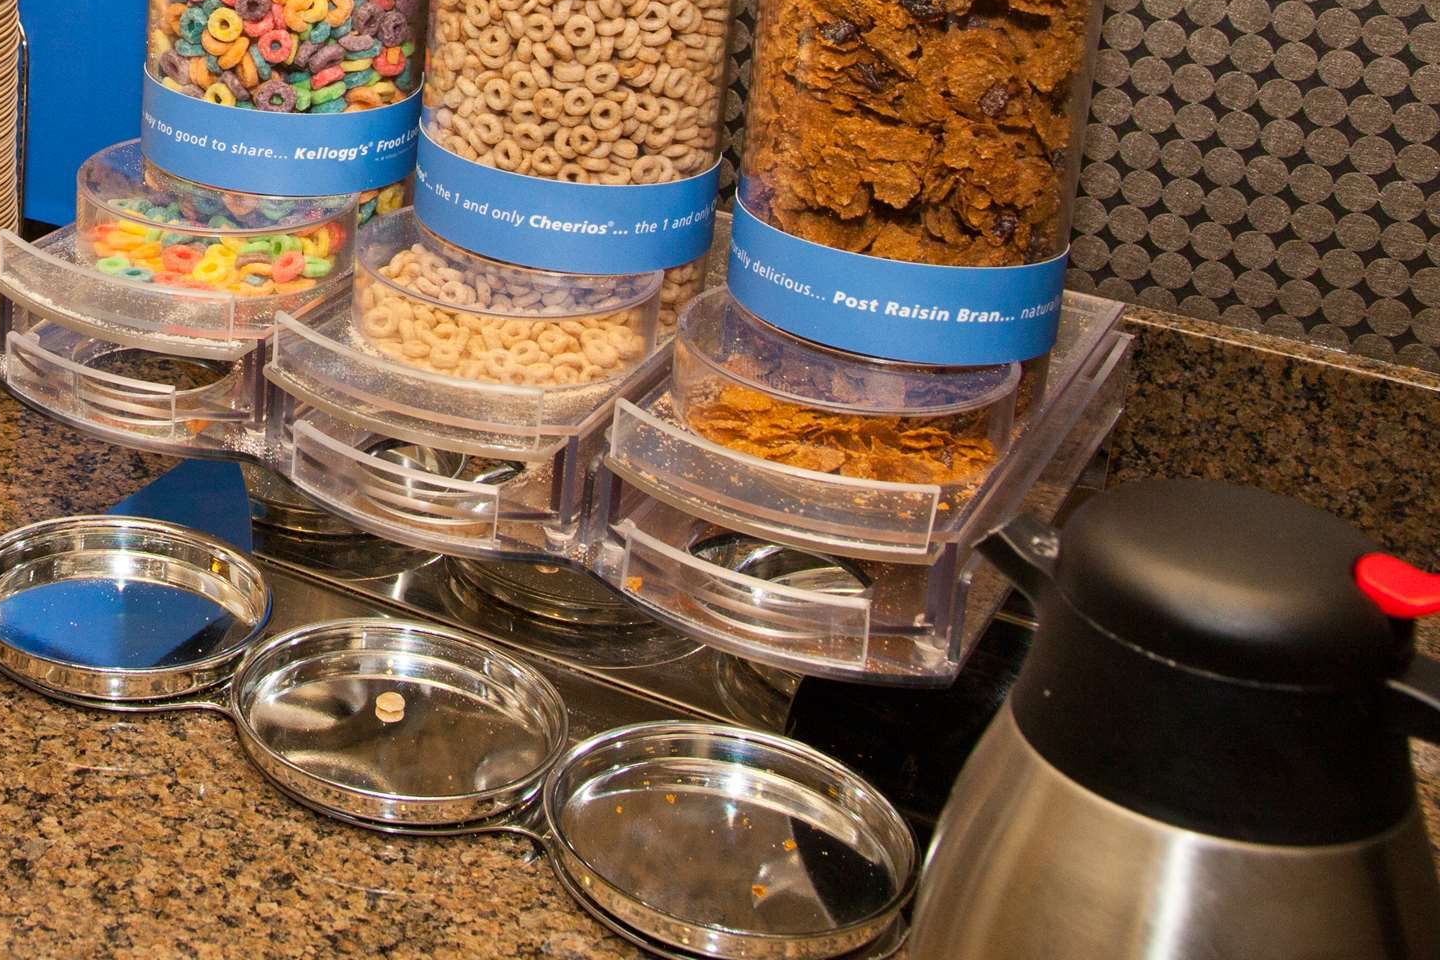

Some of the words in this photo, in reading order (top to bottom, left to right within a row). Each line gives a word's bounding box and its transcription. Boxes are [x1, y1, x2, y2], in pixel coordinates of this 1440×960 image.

[157, 120, 173, 135] too
[175, 129, 208, 147] good
[212, 139, 227, 152] to
[231, 143, 288, 159] share...
[376, 134, 405, 153] Froot
[435, 183, 451, 201] the
[454, 193, 460, 204] 1
[463, 199, 489, 216] and
[491, 209, 525, 227] only
[634, 220, 657, 234] the
[662, 218, 668, 232] 1
[671, 210, 694, 229] and
[752, 261, 825, 301] delicious...
[832, 291, 879, 313] Post
[884, 301, 950, 322] Raisin
[955, 307, 1015, 323] Bran...
